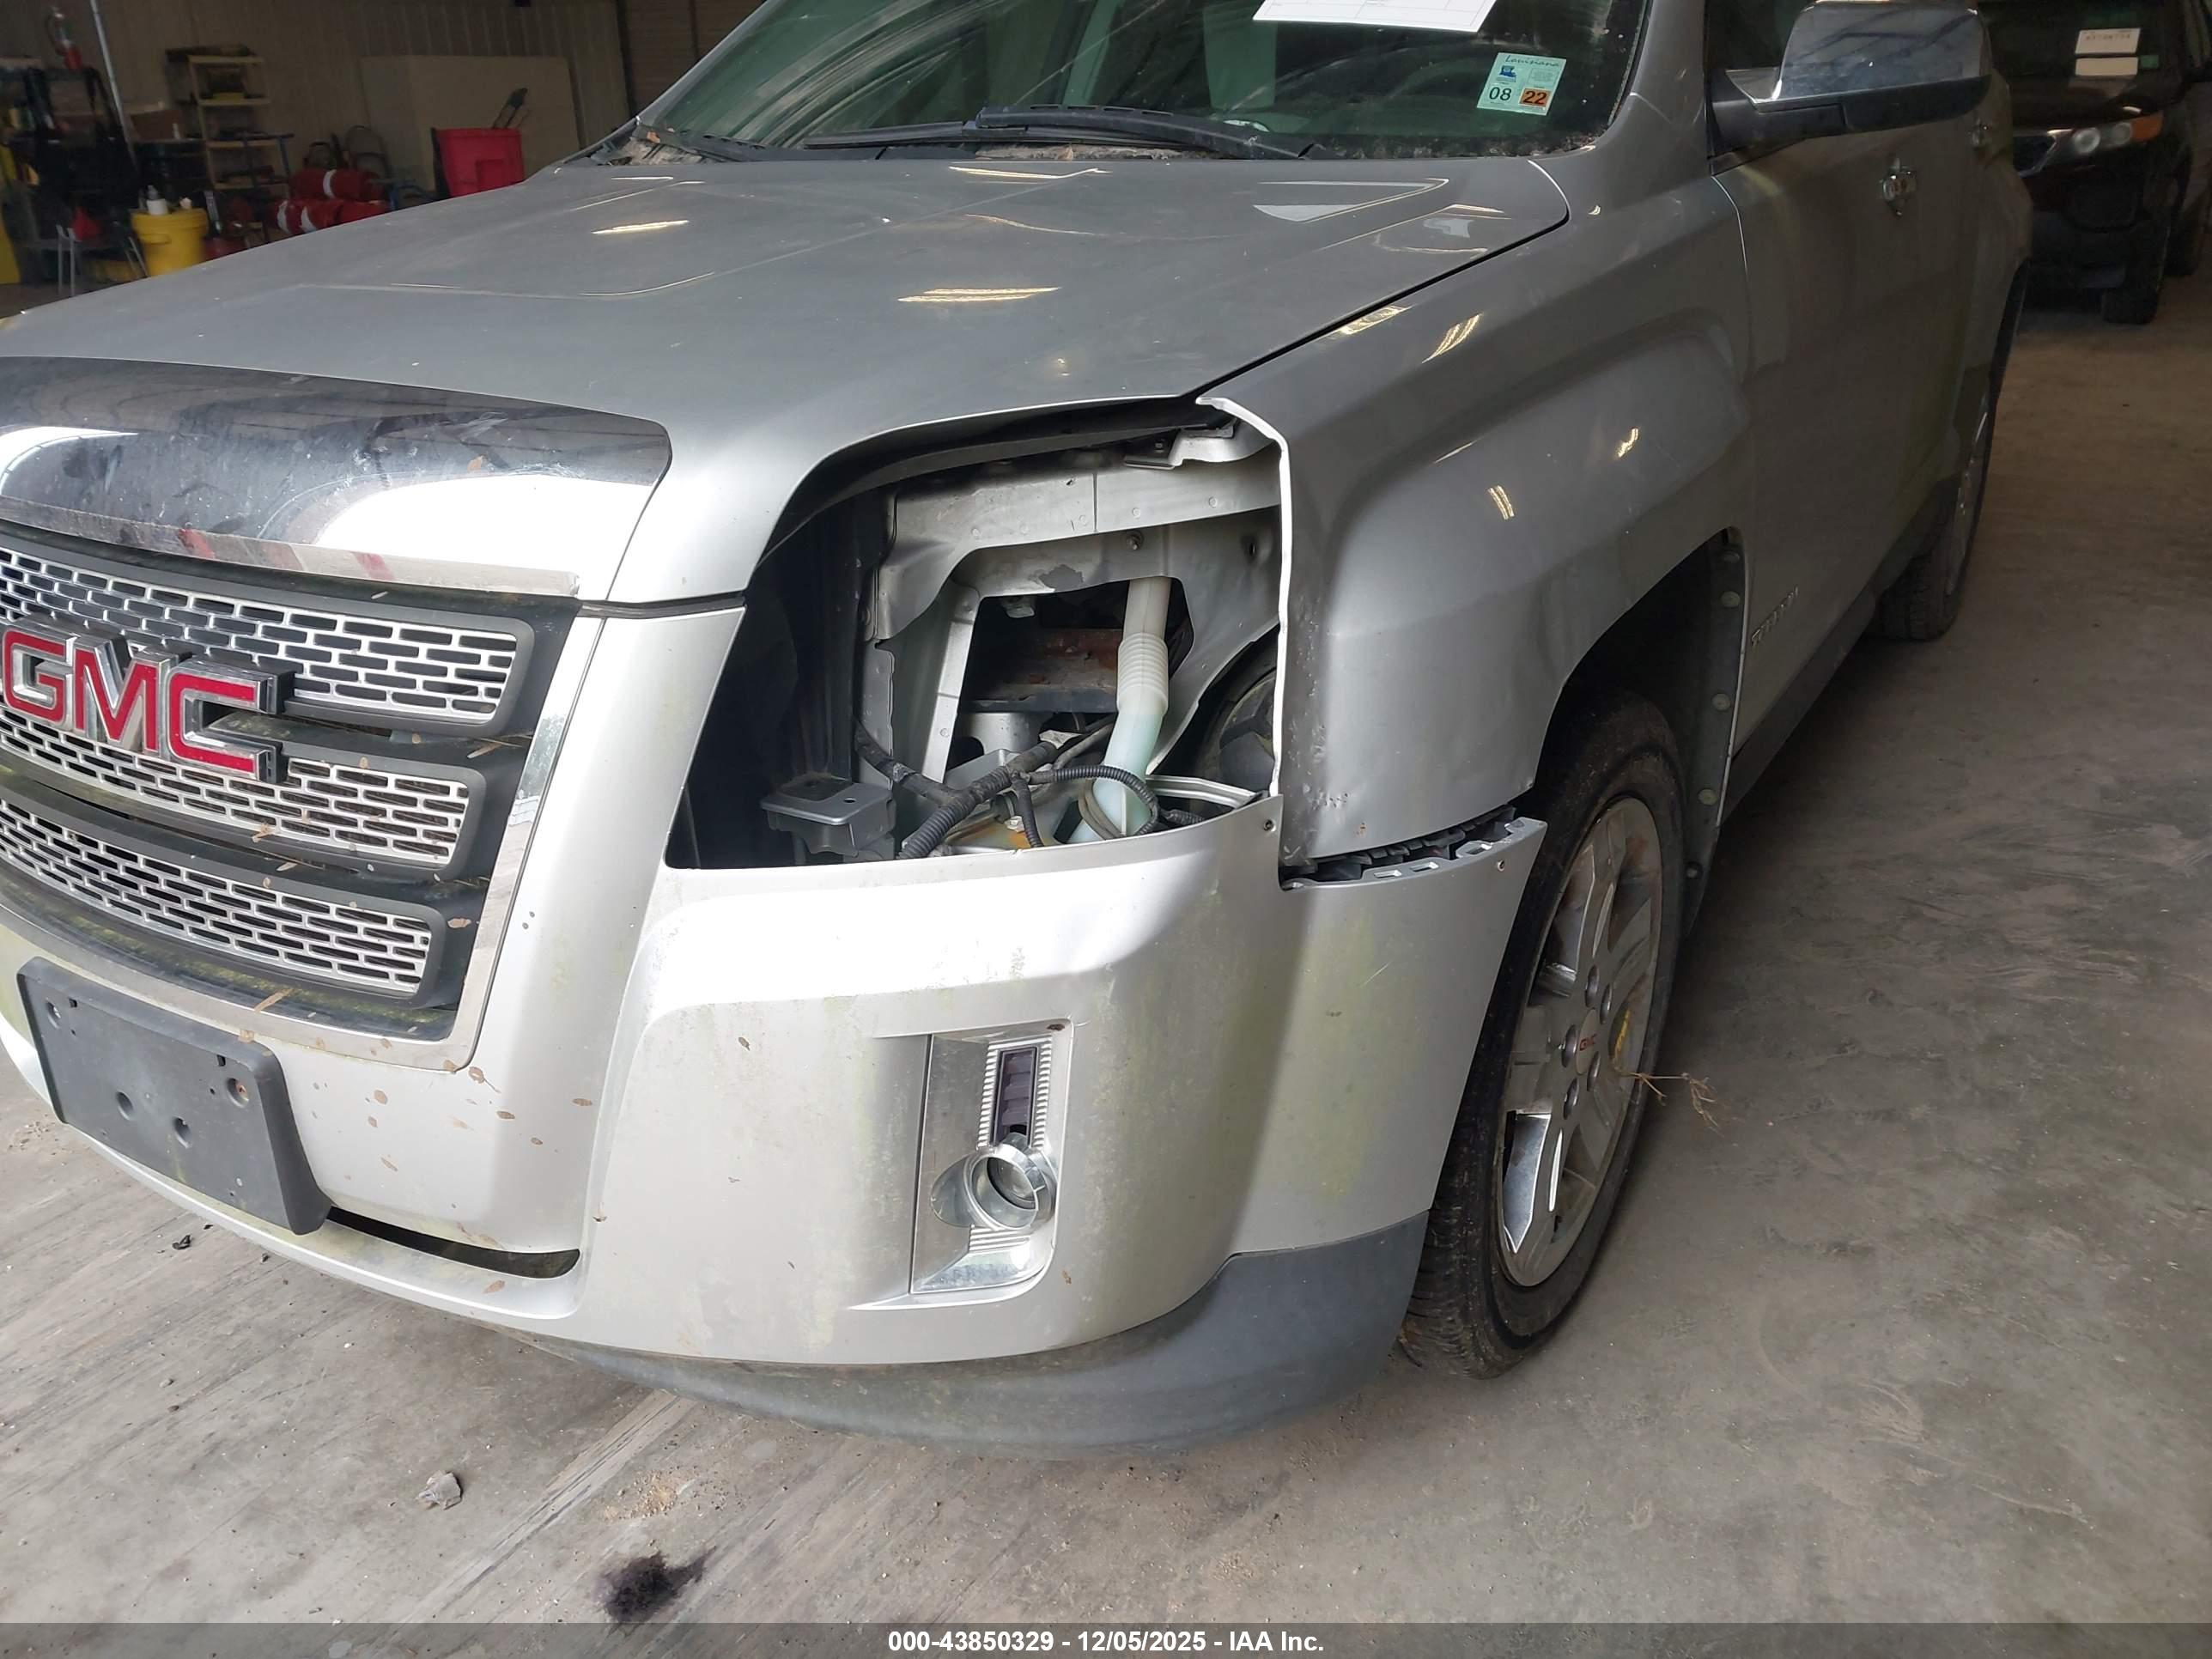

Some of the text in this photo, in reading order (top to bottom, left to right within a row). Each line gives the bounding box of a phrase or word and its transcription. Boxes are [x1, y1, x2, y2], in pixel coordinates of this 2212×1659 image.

[1504, 54, 1560, 67] Louisiana
[1489, 87, 1511, 100] 08
[1522, 90, 1547, 105] 22
[2, 626, 270, 779] GMC
